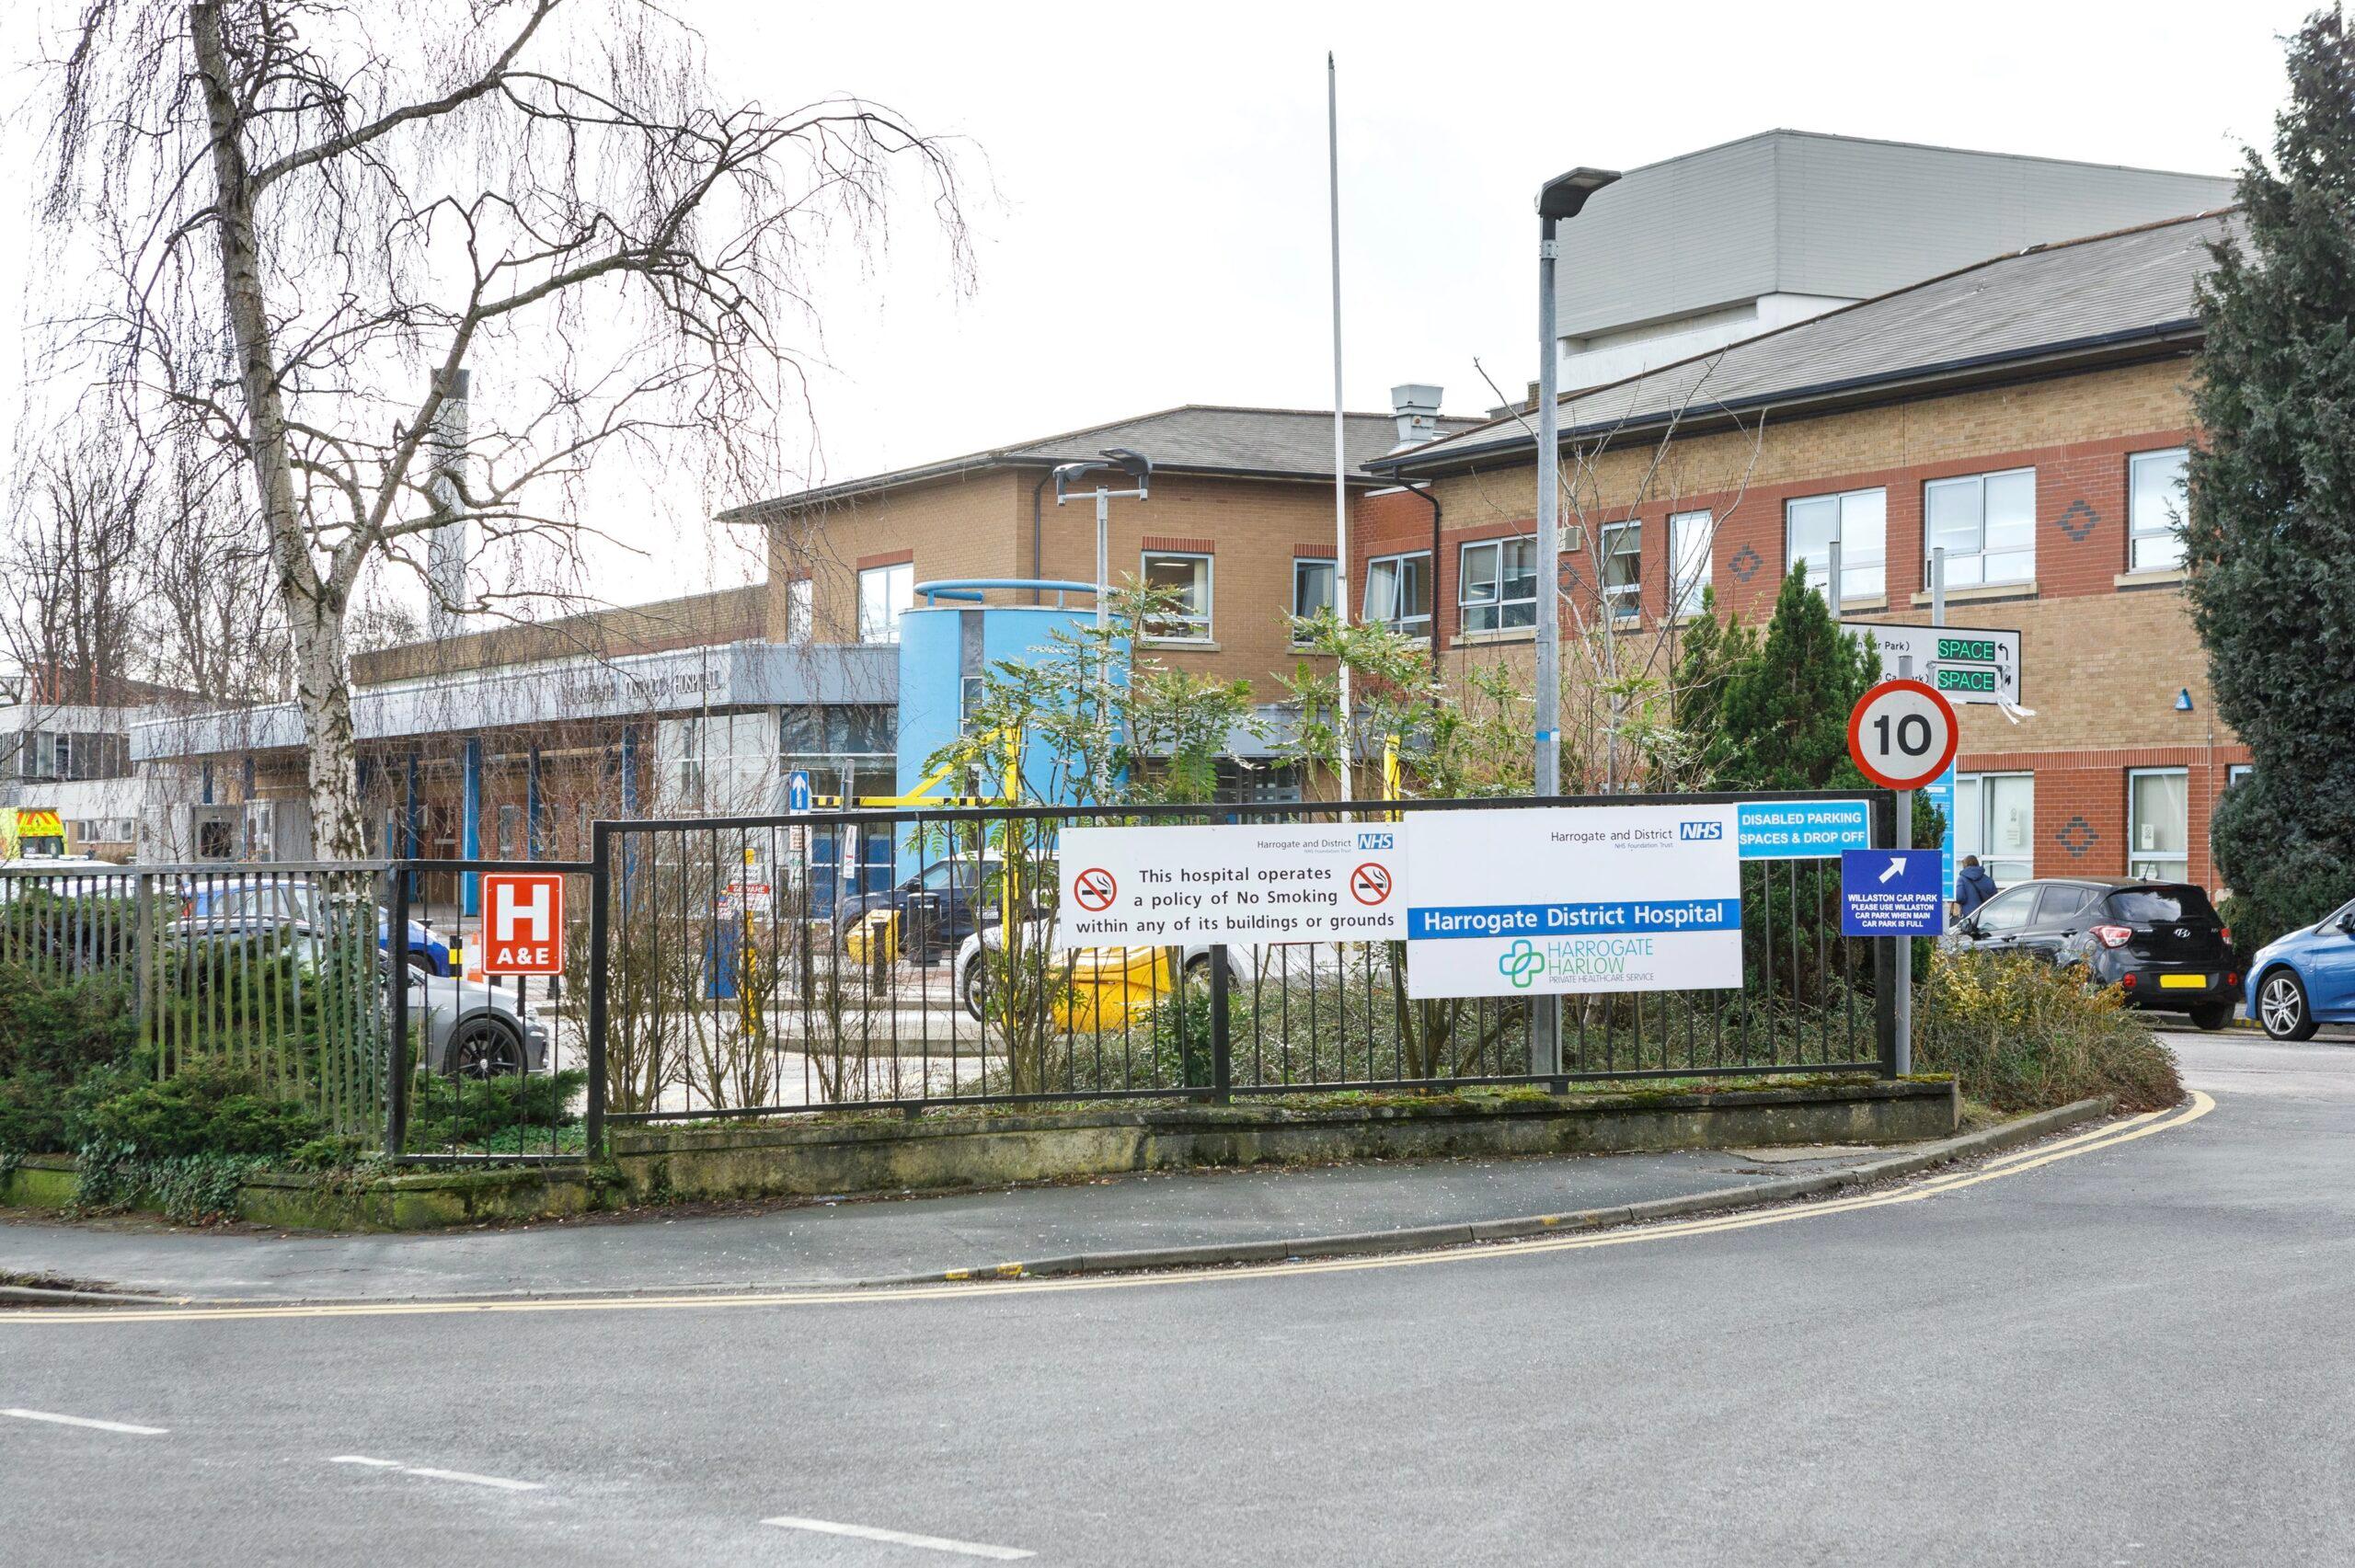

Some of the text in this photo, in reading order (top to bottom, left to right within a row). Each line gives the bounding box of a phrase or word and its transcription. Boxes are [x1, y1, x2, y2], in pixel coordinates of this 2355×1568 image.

[1885, 641, 1910, 651] Park)
[1938, 640, 1993, 659] SPACE
[1938, 671, 1993, 690] SPACE
[1874, 714, 1932, 756] 10
[1742, 812, 1861, 825] DISABLED PARKING
[1551, 828, 1672, 843] Harrogate and District
[1681, 822, 1721, 840] NHS
[1740, 831, 1865, 844] SPACES & DROP OFF
[1258, 839, 1351, 851] Harrogate and District
[1359, 834, 1392, 849] NHS
[1139, 867, 1331, 885] This hospital operates
[1134, 889, 1338, 909] a policy of No Smoking
[497, 884, 549, 941] H
[1424, 902, 1722, 934] Harrogate District Hospital
[1076, 912, 1394, 934] within any of its buildings or grounds
[497, 947, 549, 965] A&E
[1548, 939, 1653, 957] HARROGATE
[1549, 957, 1625, 975] HARLOW
[1549, 973, 1654, 983] PRIVATE HEALTHCARE SERVICE
